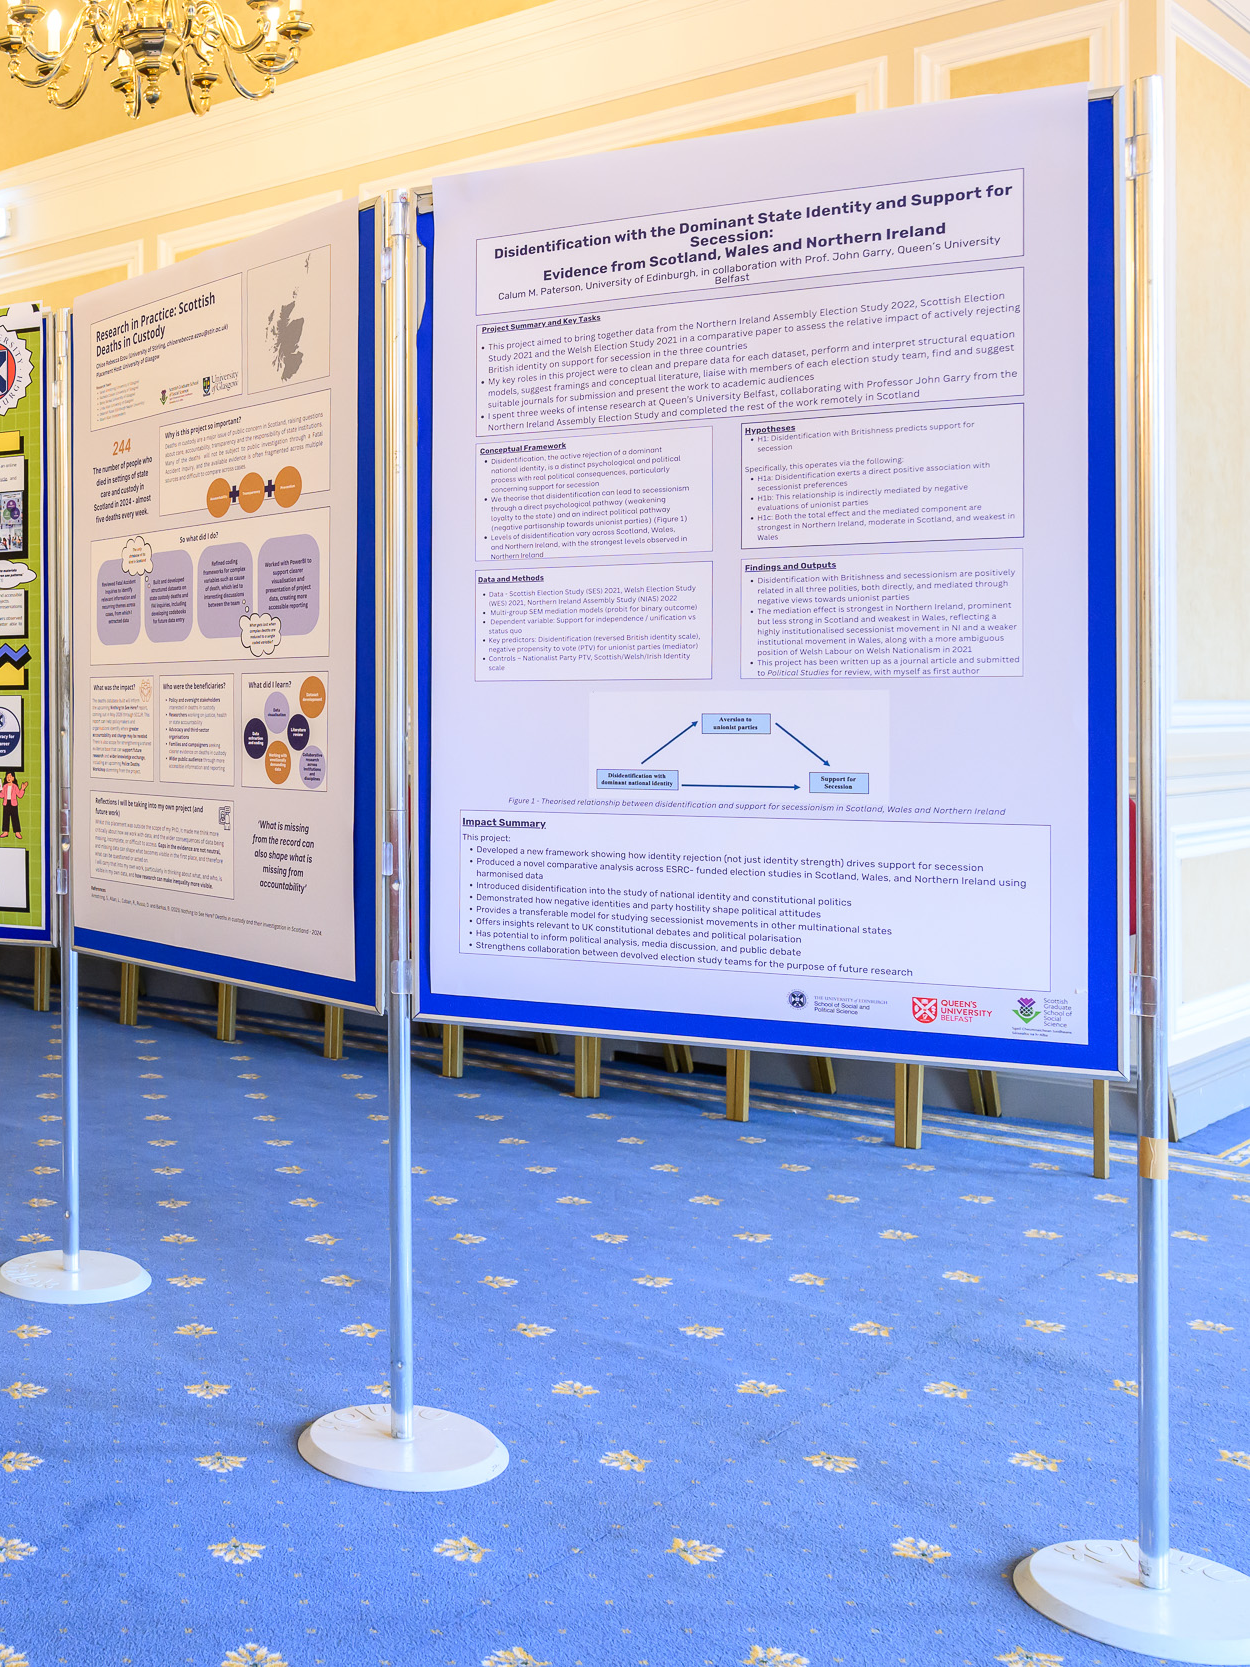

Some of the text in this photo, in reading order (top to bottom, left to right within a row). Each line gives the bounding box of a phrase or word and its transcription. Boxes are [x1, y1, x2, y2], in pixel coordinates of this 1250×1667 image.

[495, 186, 1012, 259] Disidentification with the Dominant State Identity and Support for
[690, 230, 773, 247] Secession:
[543, 222, 946, 281] Evidence from Scotland, Wales and Northern Ireland
[97, 292, 216, 342] Research in Practice: Scottish
[482, 324, 509, 333] Project
[510, 322, 546, 330] Summary
[547, 318, 561, 326] and
[578, 315, 601, 323] Tasks
[97, 326, 166, 357] Deaths in Custody
[165, 431, 175, 439] Why
[180, 428, 189, 436] this
[190, 424, 207, 436] project
[213, 416, 242, 429] important?
[745, 425, 796, 436] Hypotheses
[113, 438, 131, 456] 244
[480, 442, 567, 455] Conceptual Framework
[745, 561, 837, 572] Findings and Outputs
[278, 822, 283, 831] is
[284, 823, 309, 835] missing
[462, 818, 547, 829] Impact Summary
[252, 834, 268, 844] from
[269, 836, 278, 845] the
[280, 838, 301, 847] record
[255, 849, 313, 863] also shape what is
[263, 865, 304, 878] missing from
[941, 1000, 978, 1008] QUEEN'S
[941, 1008, 993, 1016] UNIVERSITY
[941, 1015, 973, 1023] BELFAST
